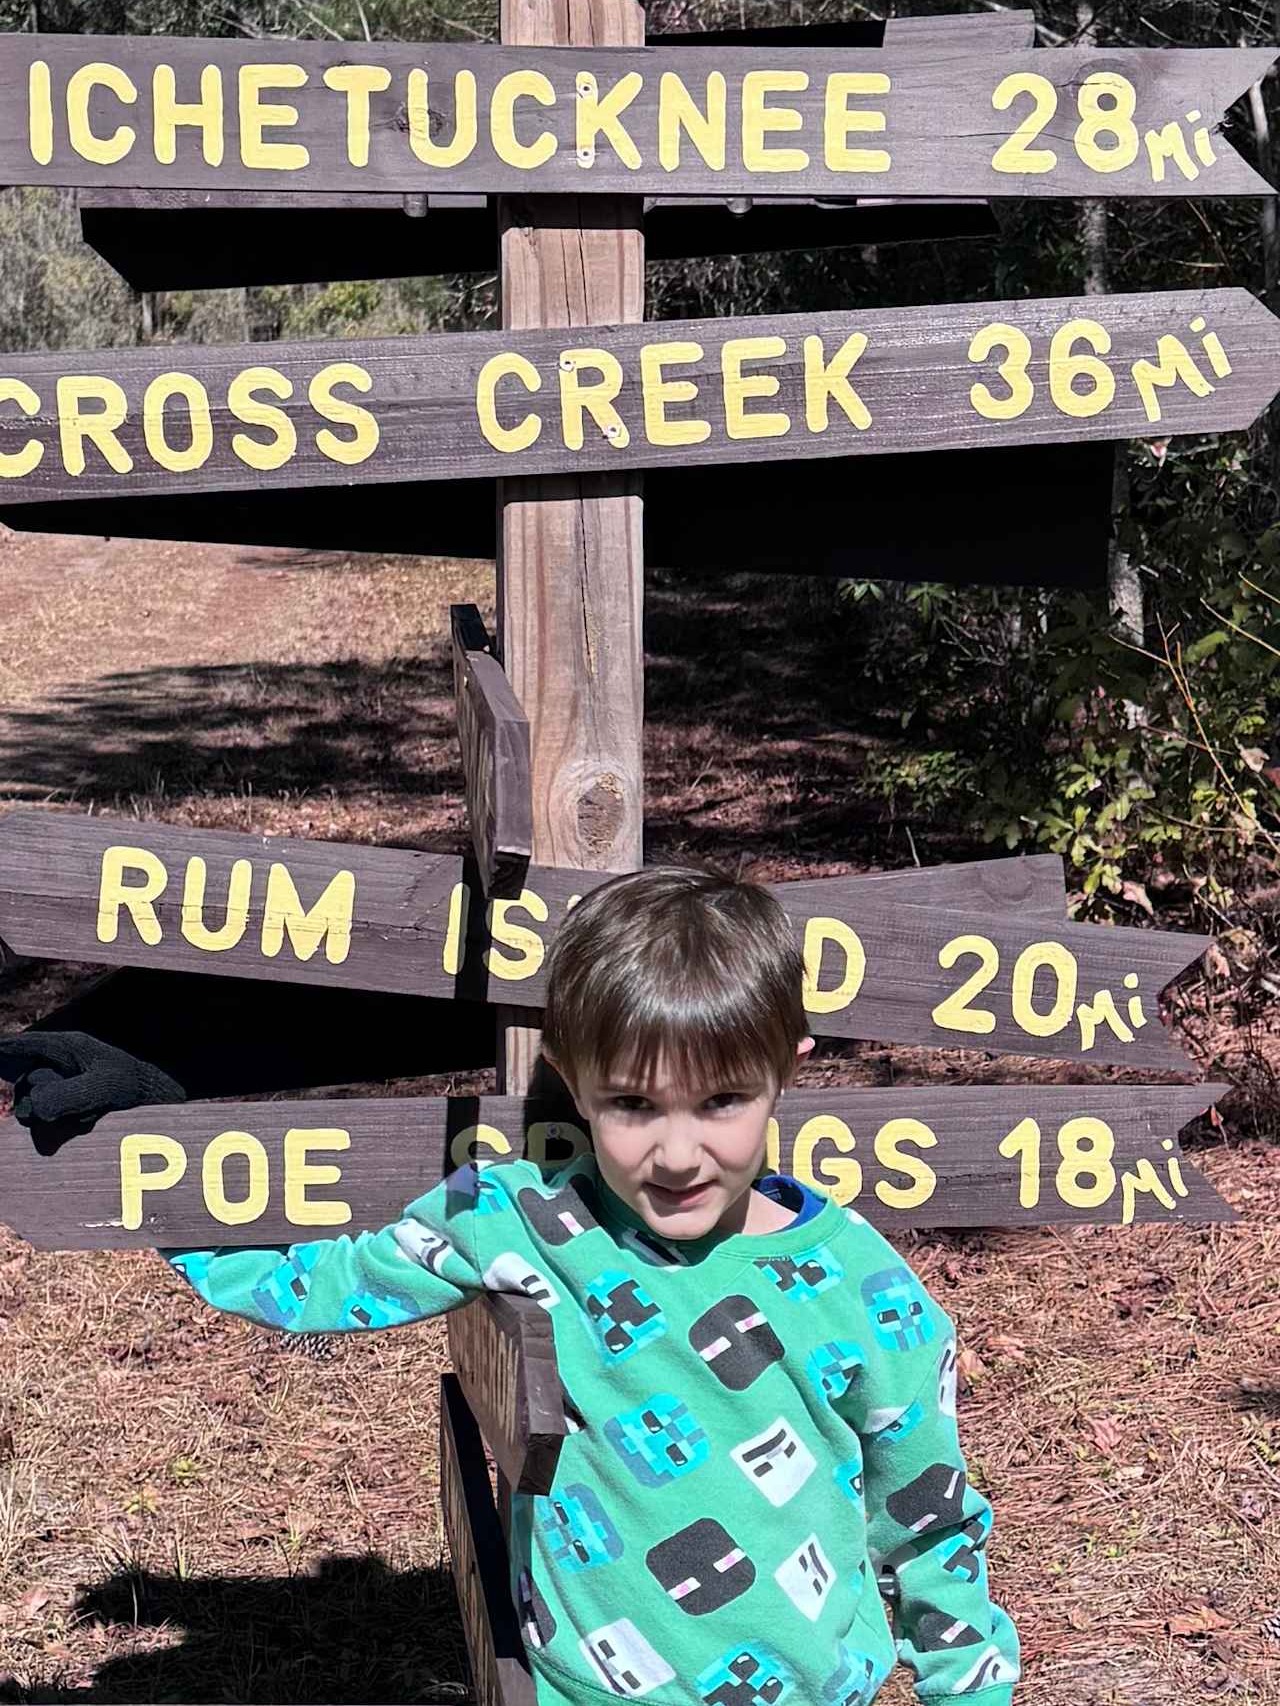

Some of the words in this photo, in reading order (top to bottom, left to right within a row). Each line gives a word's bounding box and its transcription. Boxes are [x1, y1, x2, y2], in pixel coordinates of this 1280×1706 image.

[28, 60, 891, 173] ICHETUCKNEE
[475, 331, 873, 454] CREEK
[95, 845, 355, 966] RUM
[442, 881, 866, 1014] ISD
[119, 1127, 352, 1230] POE
